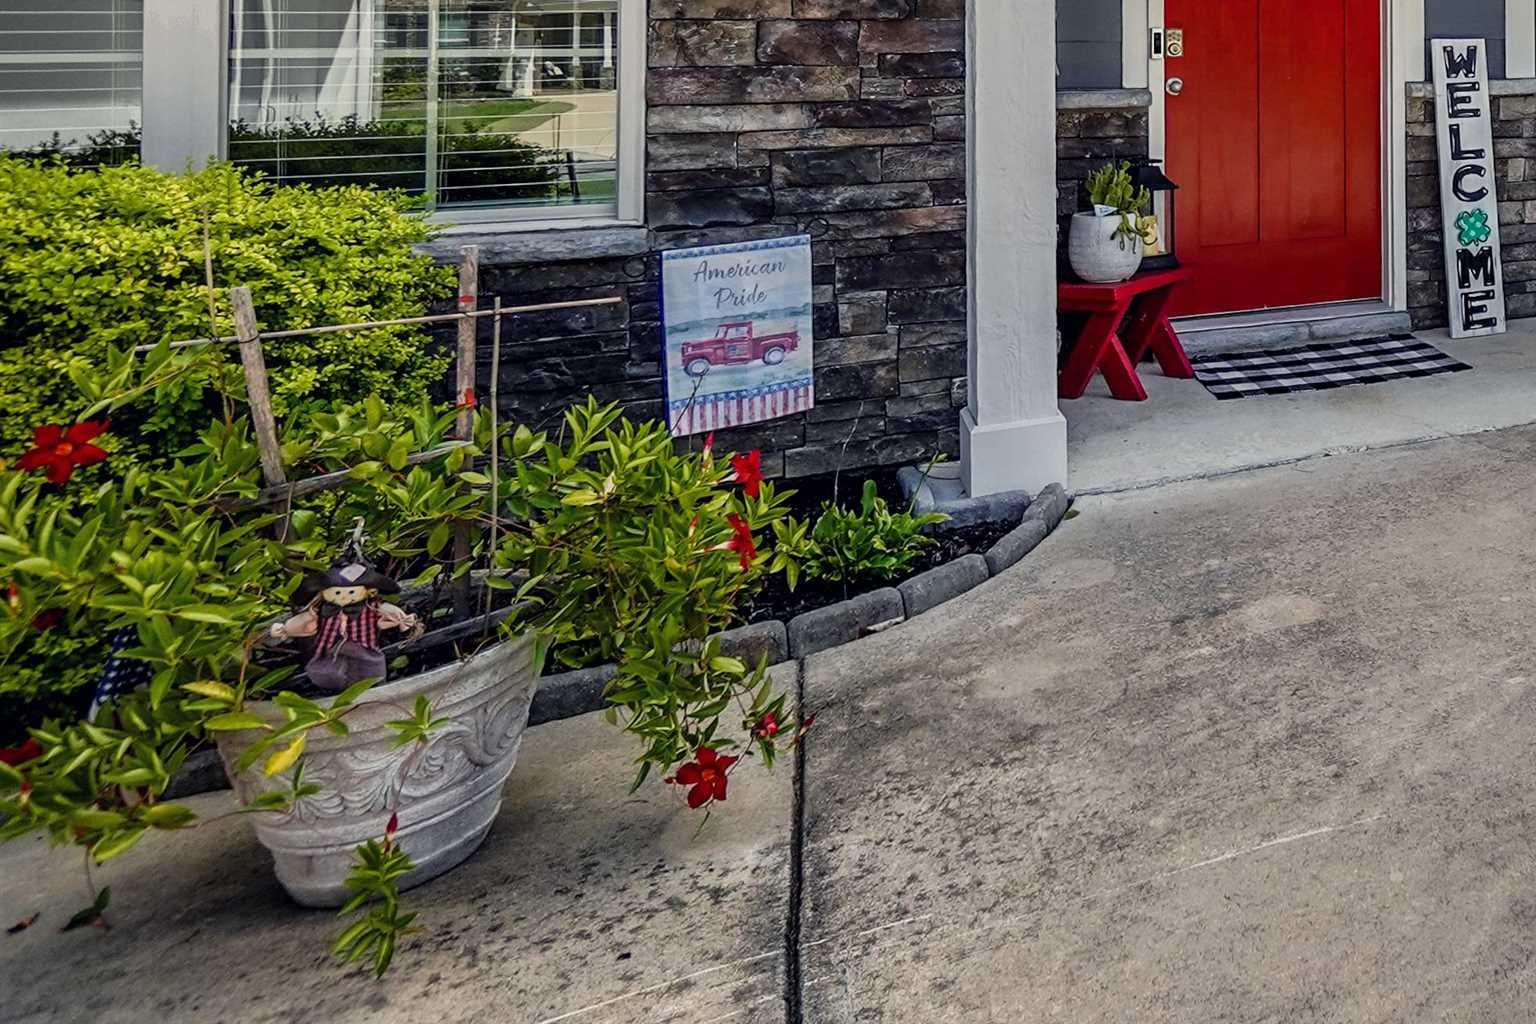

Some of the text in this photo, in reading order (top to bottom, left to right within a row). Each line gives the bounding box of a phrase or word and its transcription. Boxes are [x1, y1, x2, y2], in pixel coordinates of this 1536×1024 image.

[1443, 45, 1497, 331] WELCME
[694, 259, 785, 282] American
[714, 284, 767, 309] Pride
